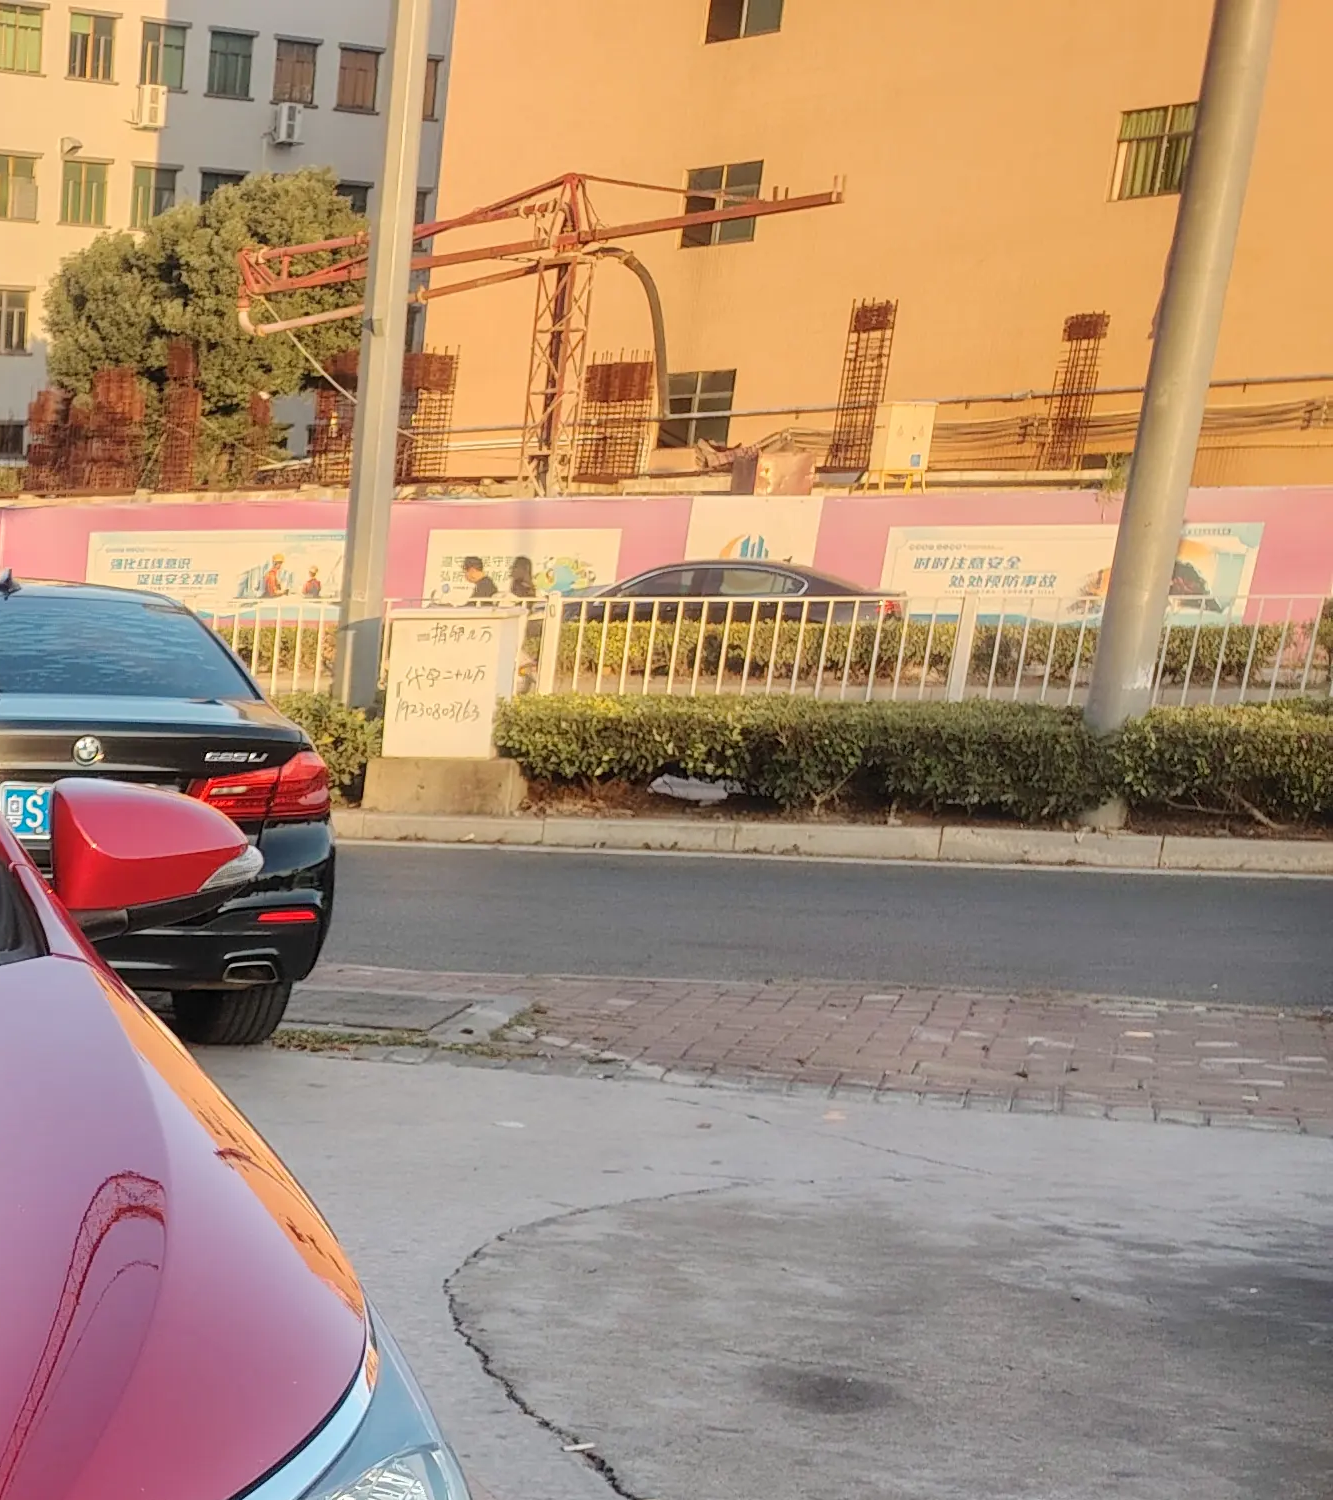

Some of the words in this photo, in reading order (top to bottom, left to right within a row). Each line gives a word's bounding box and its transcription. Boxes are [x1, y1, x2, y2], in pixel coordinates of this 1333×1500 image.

[110, 558, 191, 570] 强化红线意识
[913, 556, 1021, 570] 时时注意安全
[136, 573, 219, 586] 促进安全发展
[948, 574, 1058, 589] 处处预防事故
